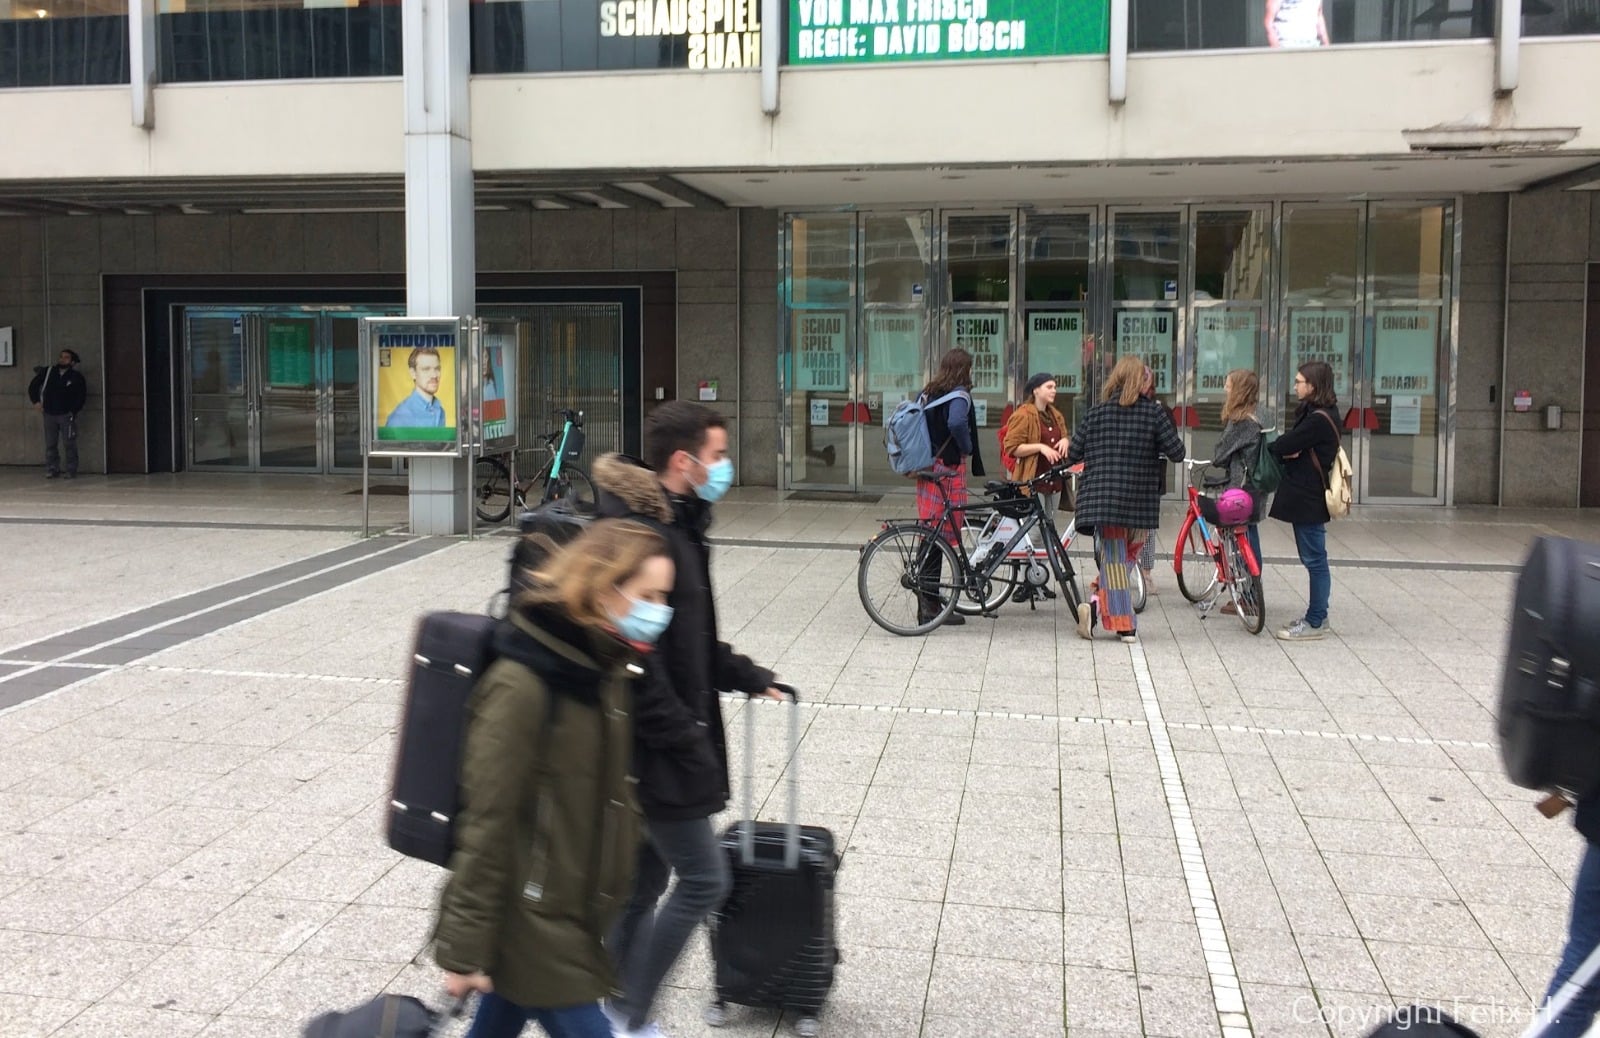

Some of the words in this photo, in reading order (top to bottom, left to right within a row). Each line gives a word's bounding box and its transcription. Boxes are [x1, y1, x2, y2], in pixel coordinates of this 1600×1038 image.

[600, 0, 761, 37] SCHAUSPIEL
[798, 0, 843, 26] VON
[850, 0, 900, 24] MAX
[906, 0, 988, 22] FRISCH
[798, 27, 867, 59] REGIE:
[873, 24, 941, 56] DAVID
[948, 18, 1026, 53] BÖSCH
[802, 318, 841, 334] SCHAU
[956, 319, 999, 335] SCHAU
[1034, 317, 1078, 331] EINGANG
[1122, 317, 1167, 334] SCHAU
[1297, 316, 1343, 333] SCHAU
[802, 335, 833, 351] SPIEL
[956, 336, 990, 353] SPIEL
[1122, 335, 1158, 352] SPIEL
[1297, 335, 1334, 352] SPIEL
